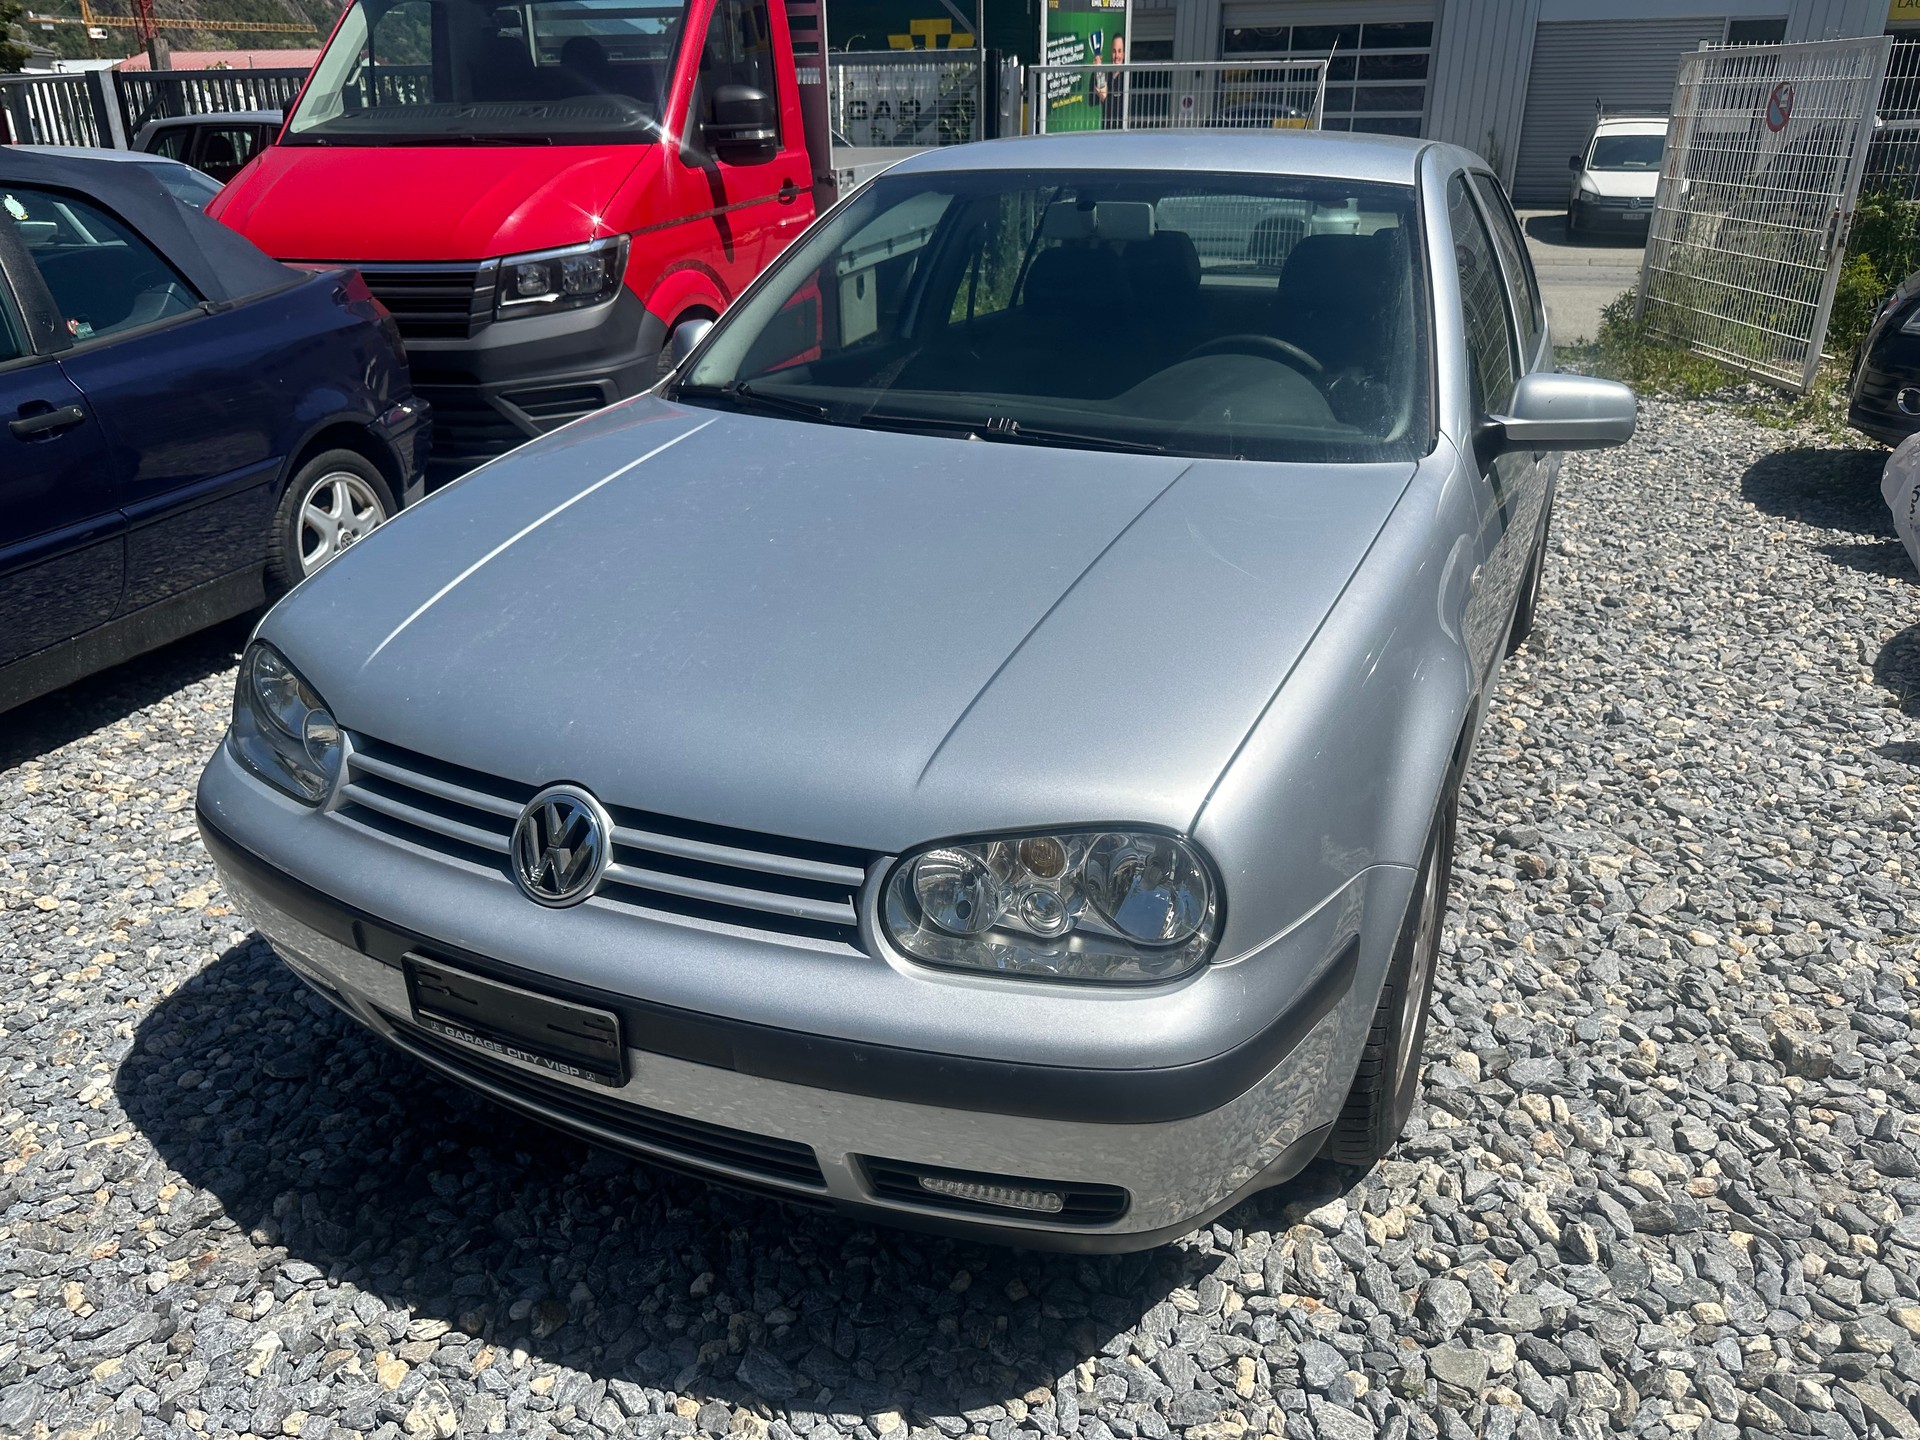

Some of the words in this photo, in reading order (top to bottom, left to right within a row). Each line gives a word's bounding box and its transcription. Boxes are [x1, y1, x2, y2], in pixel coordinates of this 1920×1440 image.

[444, 1026, 503, 1054] GARAGE
[506, 1047, 541, 1065] CITY
[543, 1059, 580, 1077] VISP
